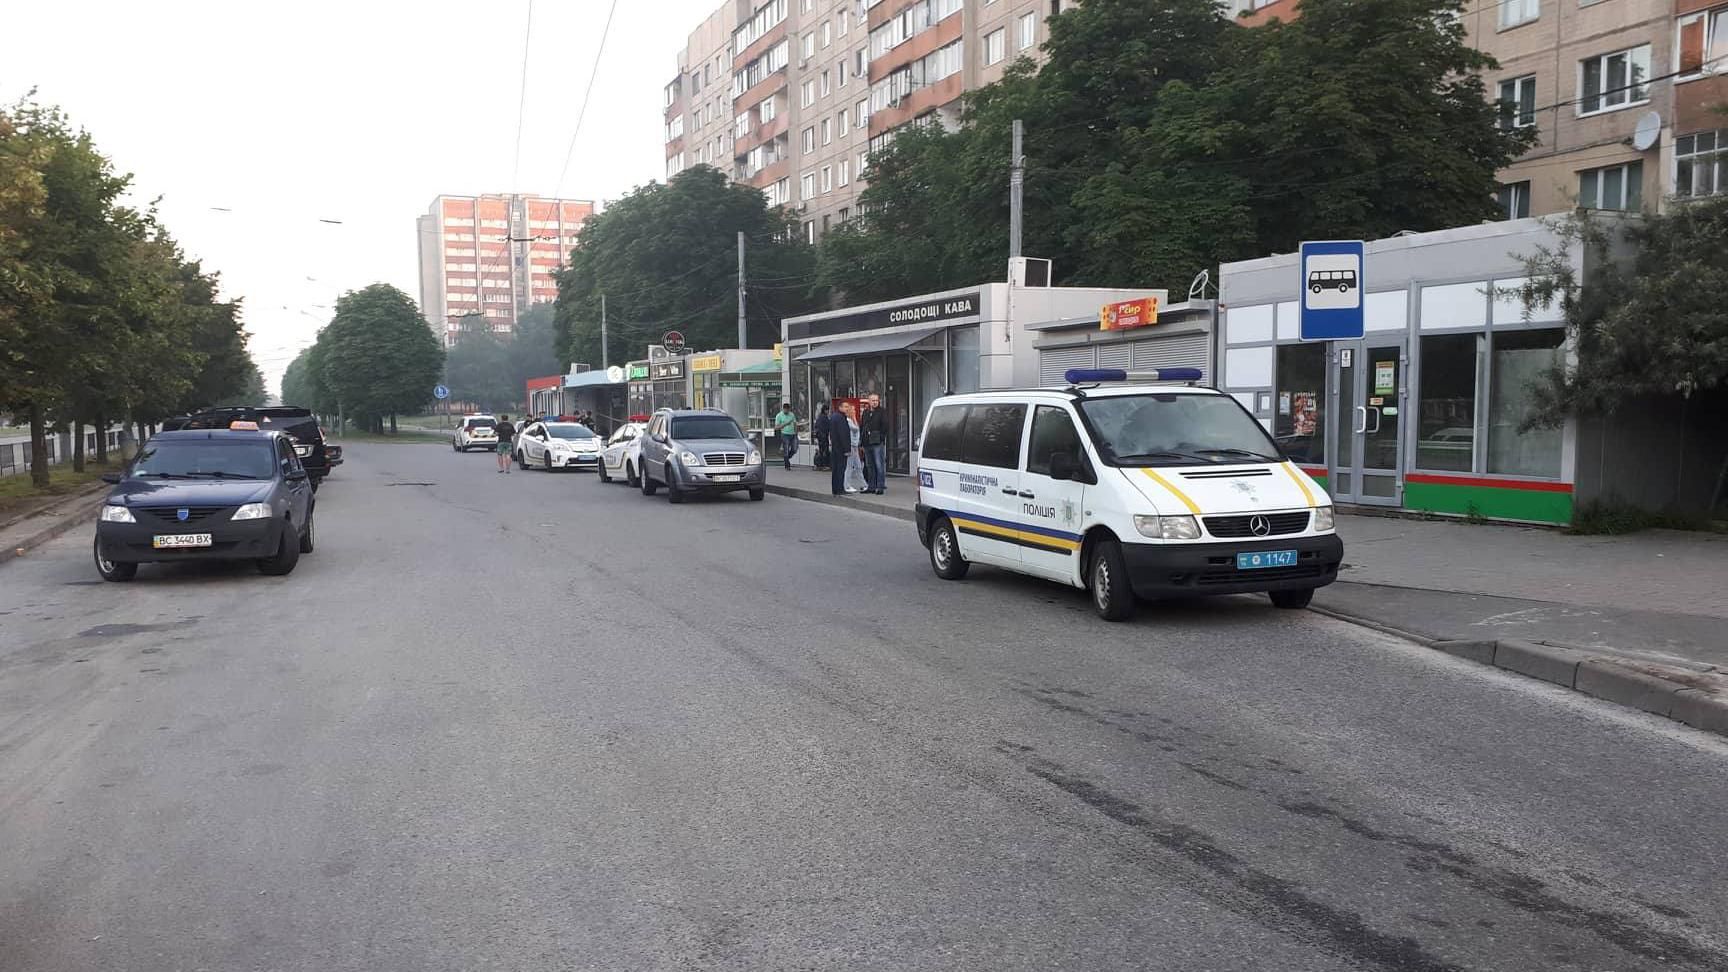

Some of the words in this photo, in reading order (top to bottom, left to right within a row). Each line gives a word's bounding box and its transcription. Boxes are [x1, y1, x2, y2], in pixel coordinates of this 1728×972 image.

[890, 305, 939, 322] СОЛОДОЩІ
[944, 300, 972, 315] КАВА
[1023, 503, 1056, 519] ПОЛІЦІЯ
[1266, 552, 1292, 566] 1147
